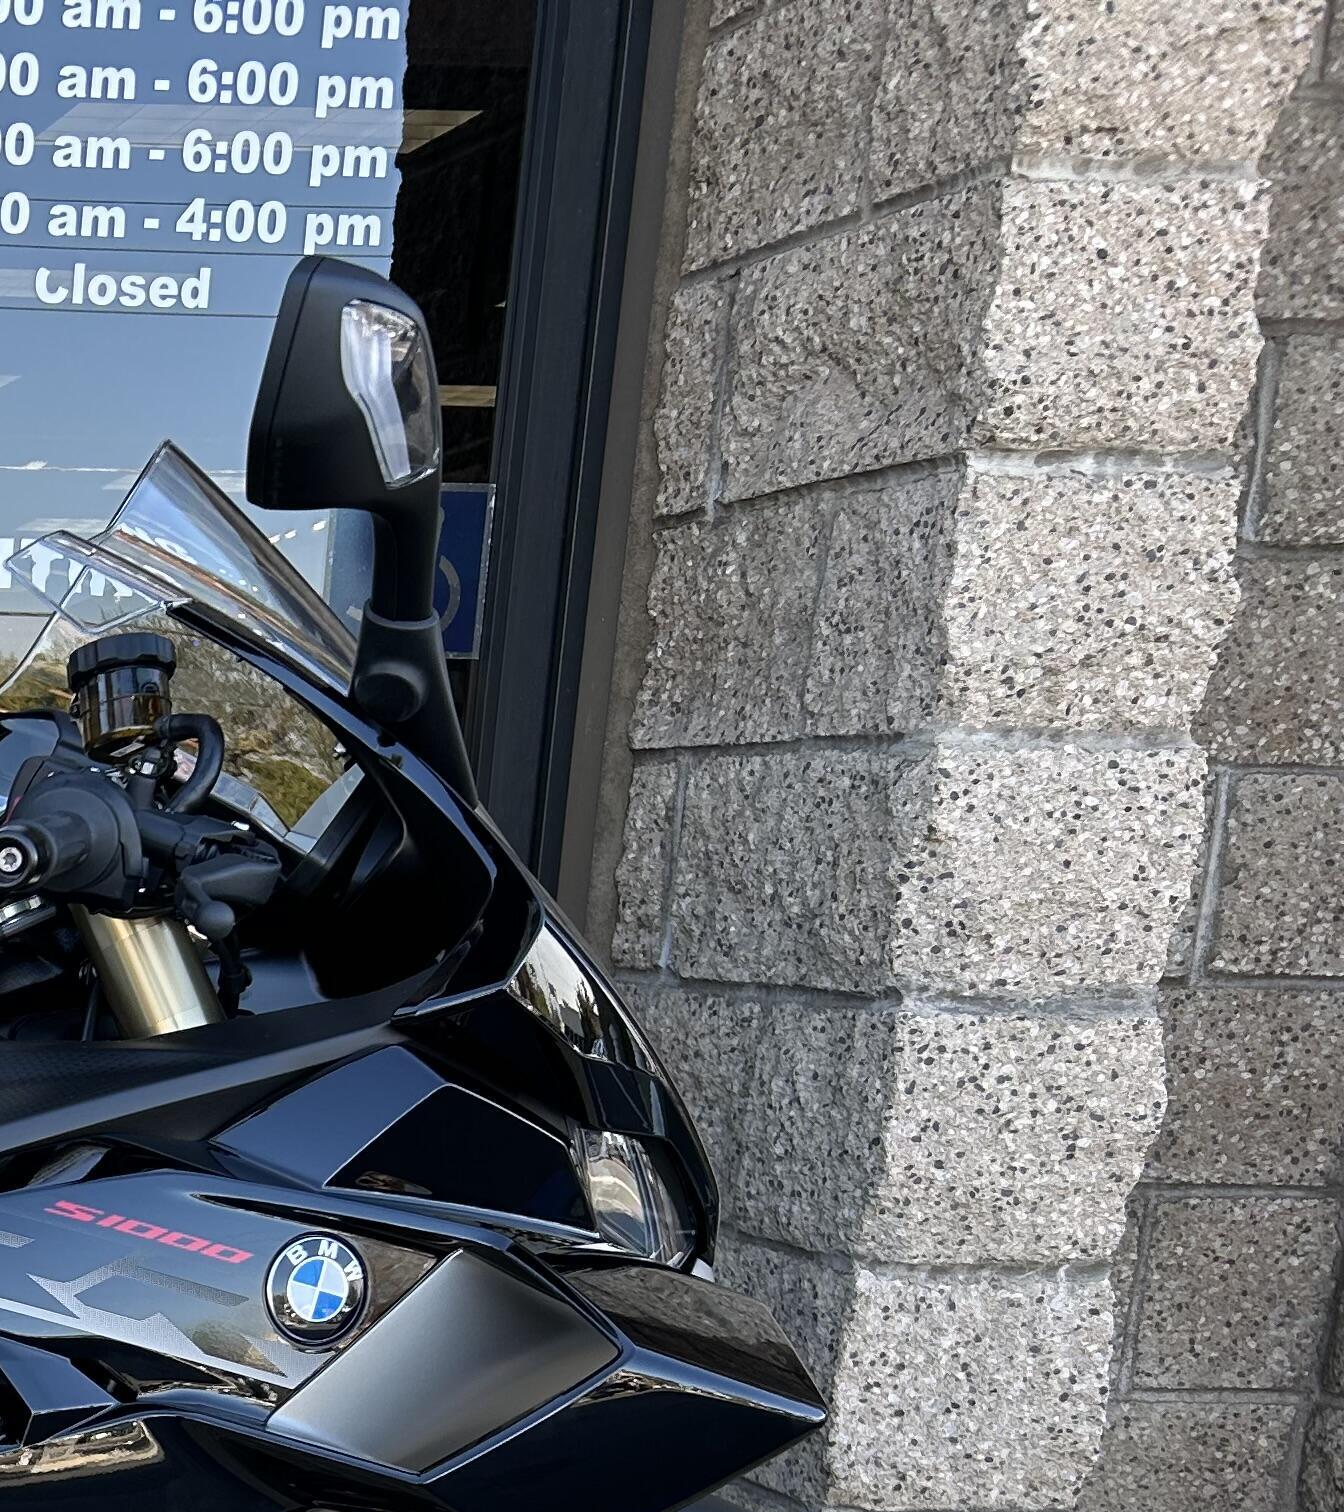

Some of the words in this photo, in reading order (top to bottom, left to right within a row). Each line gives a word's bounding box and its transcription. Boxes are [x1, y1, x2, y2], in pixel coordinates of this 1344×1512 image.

[320, 4, 401, 49] pm
[57, 65, 137, 100] am
[187, 59, 299, 106] 6:00
[314, 73, 394, 118] pm
[52, 135, 131, 170] am
[182, 129, 293, 175] 6:00
[309, 143, 388, 187] pm
[47, 204, 126, 239] am
[175, 198, 287, 244] 4:00
[303, 212, 382, 255] pm
[34, 263, 212, 309] Closed
[44, 1199, 255, 1264] S1000
[286, 1239, 364, 1282] BMW
